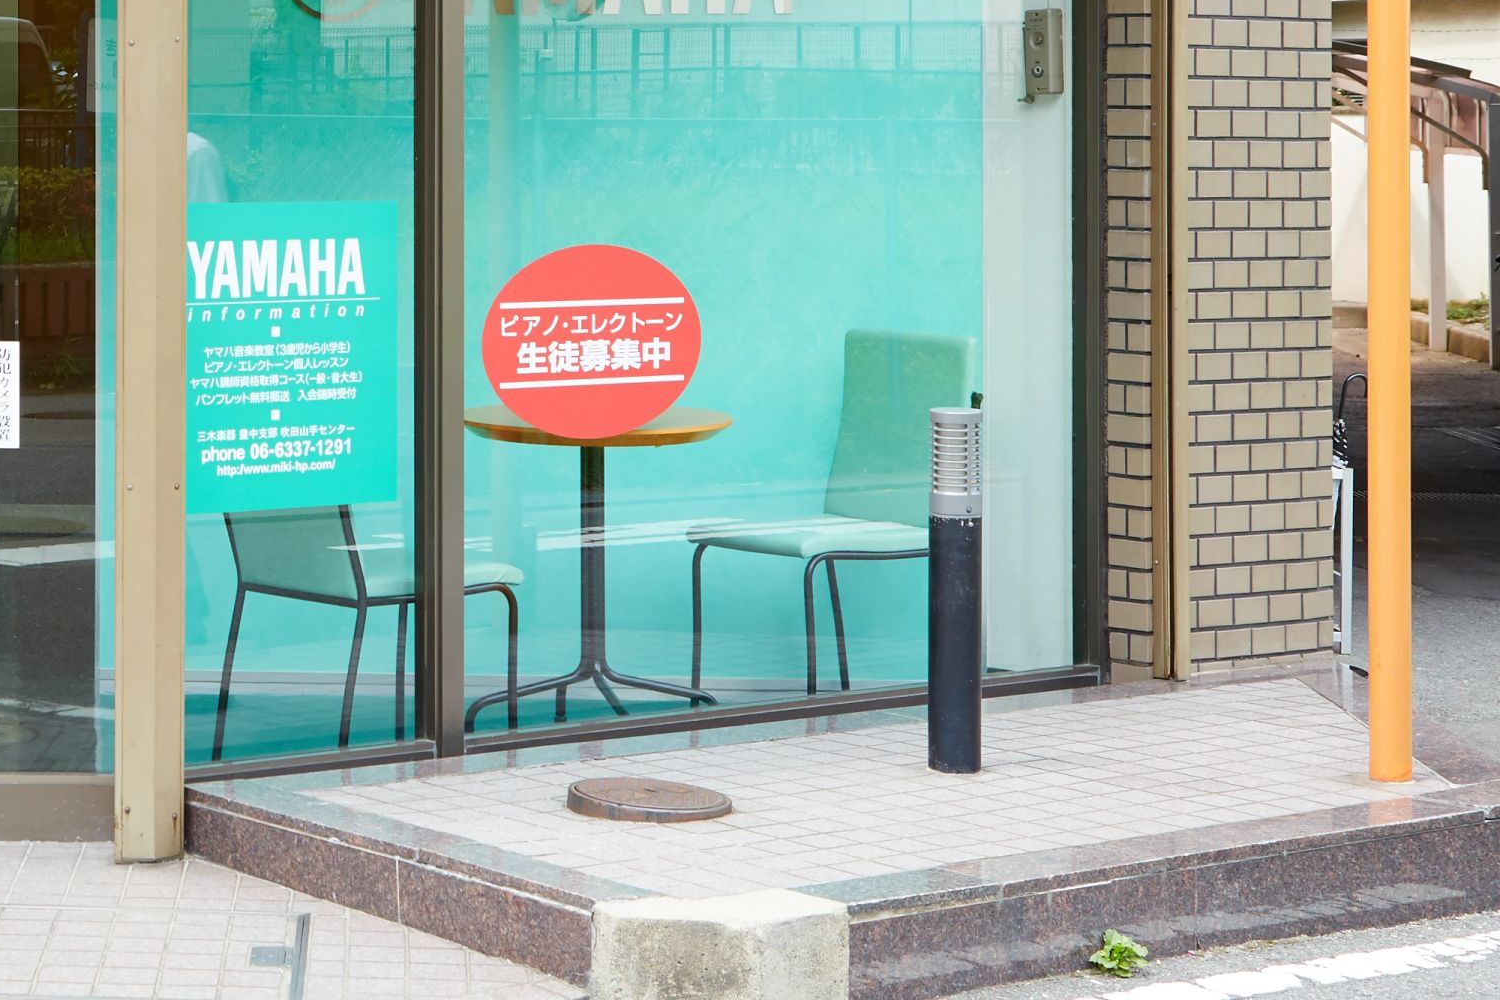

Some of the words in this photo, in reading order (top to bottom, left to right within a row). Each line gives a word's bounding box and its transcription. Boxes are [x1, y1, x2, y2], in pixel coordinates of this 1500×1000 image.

[187, 238, 366, 299] YAMAHA
[187, 304, 365, 322] information
[500, 312, 683, 337] ピアノ・エレクトーン
[516, 337, 671, 374] 生徒募集中
[197, 430, 236, 442] 三木楽器
[280, 424, 356, 438] 吹田山手センター
[201, 445, 246, 464] phone
[250, 437, 352, 460] 06-6337-1291
